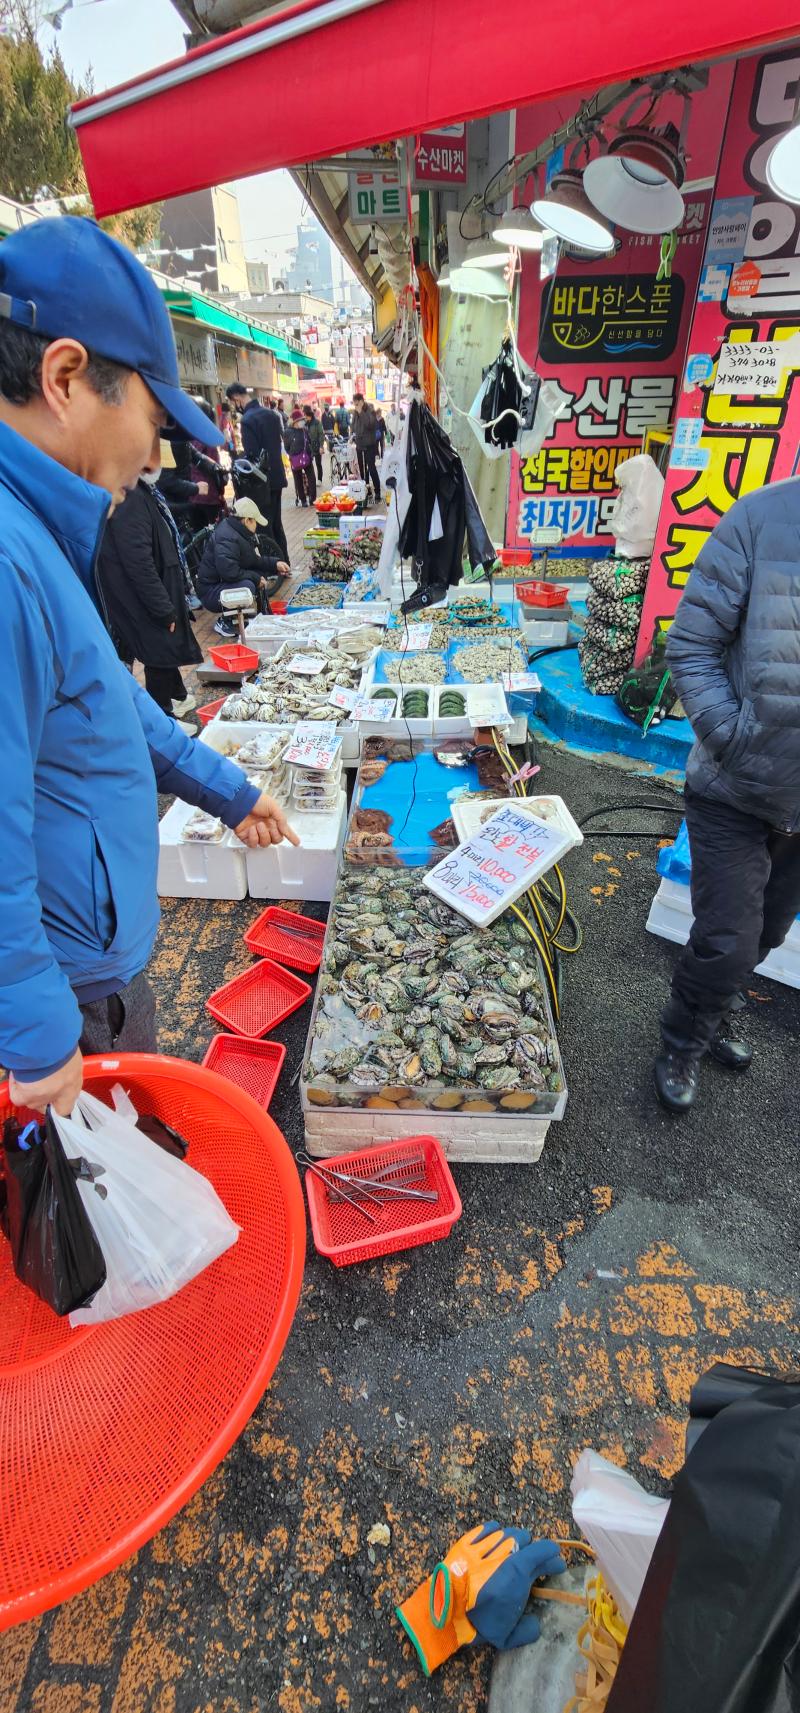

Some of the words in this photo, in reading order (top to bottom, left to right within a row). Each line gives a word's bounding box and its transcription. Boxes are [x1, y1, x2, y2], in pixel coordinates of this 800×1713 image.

[417, 147, 465, 174] 수산마켓
[357, 190, 401, 215] 마트
[628, 236, 653, 247] FISH
[659, 234, 701, 245] KET
[552, 284, 672, 316] 바다한스푼
[608, 329, 642, 339] 신선함을
[647, 328, 663, 338] 담다
[515, 842, 545, 869] 전복
